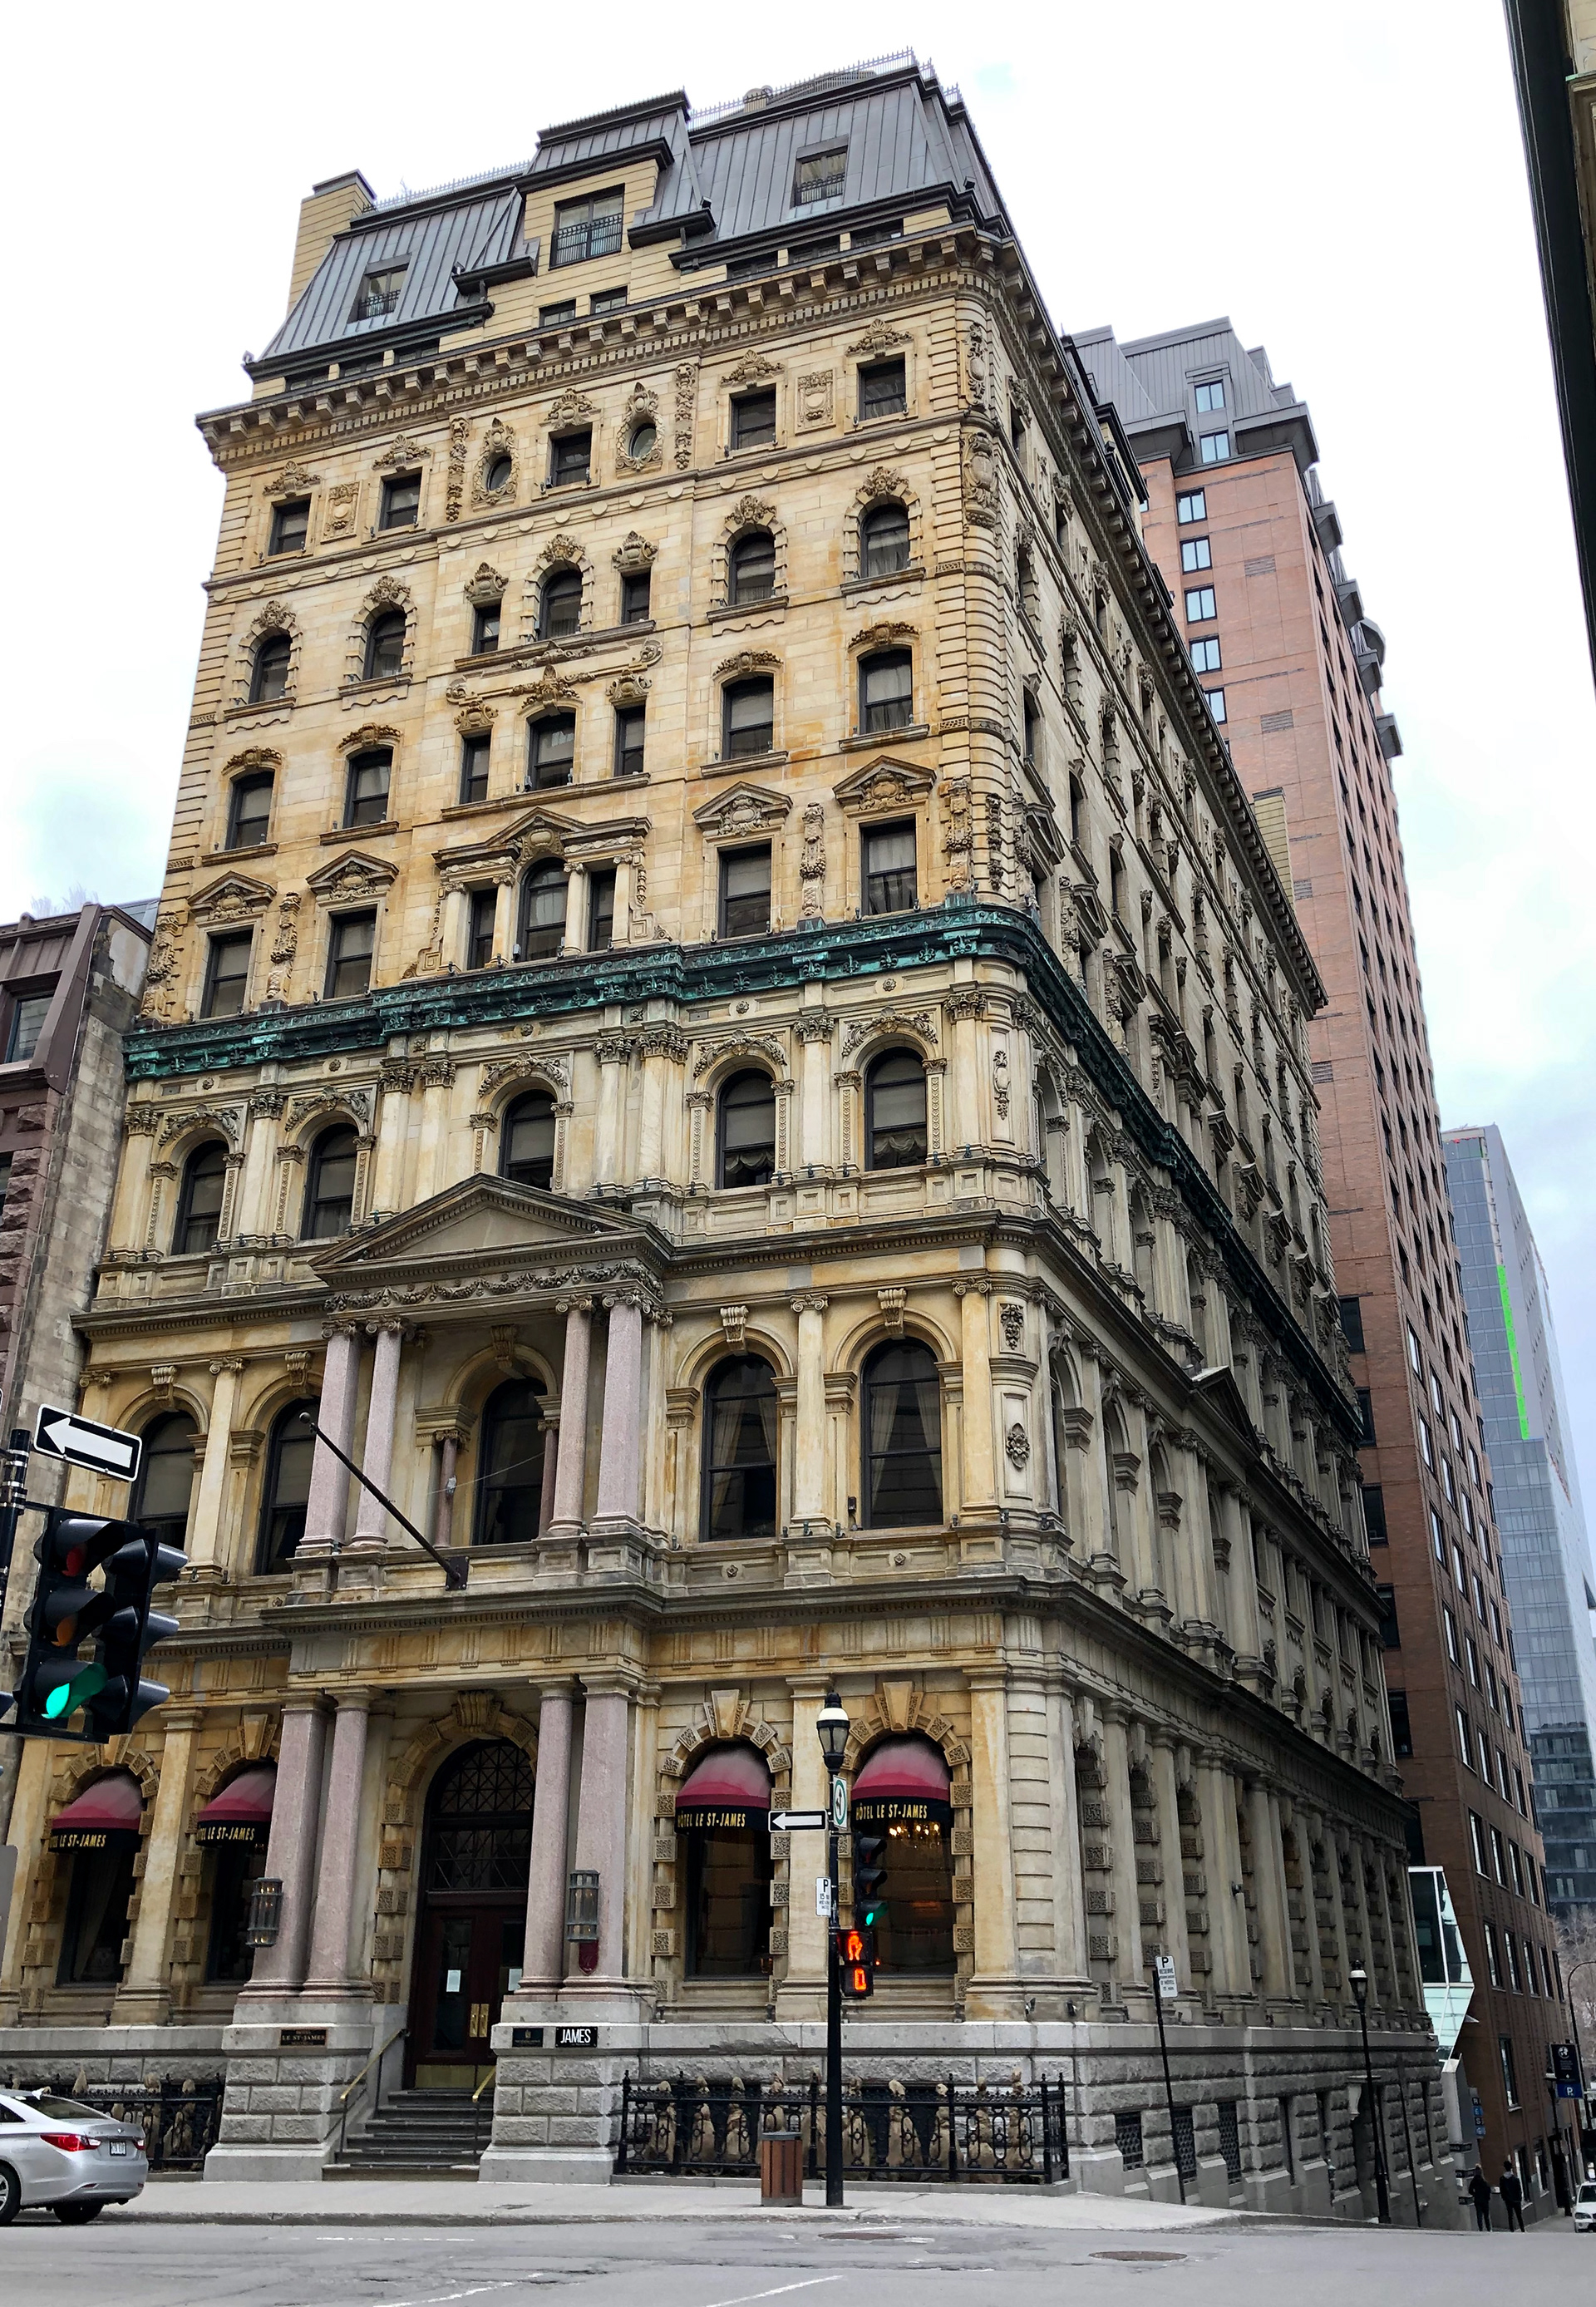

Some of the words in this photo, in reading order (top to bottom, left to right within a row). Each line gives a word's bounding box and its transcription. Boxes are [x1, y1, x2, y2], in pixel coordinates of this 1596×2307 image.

[855, 1802, 874, 1821] HÔTEL
[876, 1804, 885, 1819] LE
[888, 1803, 928, 1820] ST-JAMES
[695, 1813, 704, 1827] LE
[707, 1812, 746, 1827] ST-JAMES
[59, 1834, 67, 1847] LE
[67, 1834, 107, 1847] ST-JAMES
[207, 1826, 216, 1840] LE
[216, 1826, 255, 1841] ST-JAMES
[823, 1879, 829, 1893] P
[1161, 1956, 1170, 1968] P
[560, 2028, 592, 2043] JAMES
